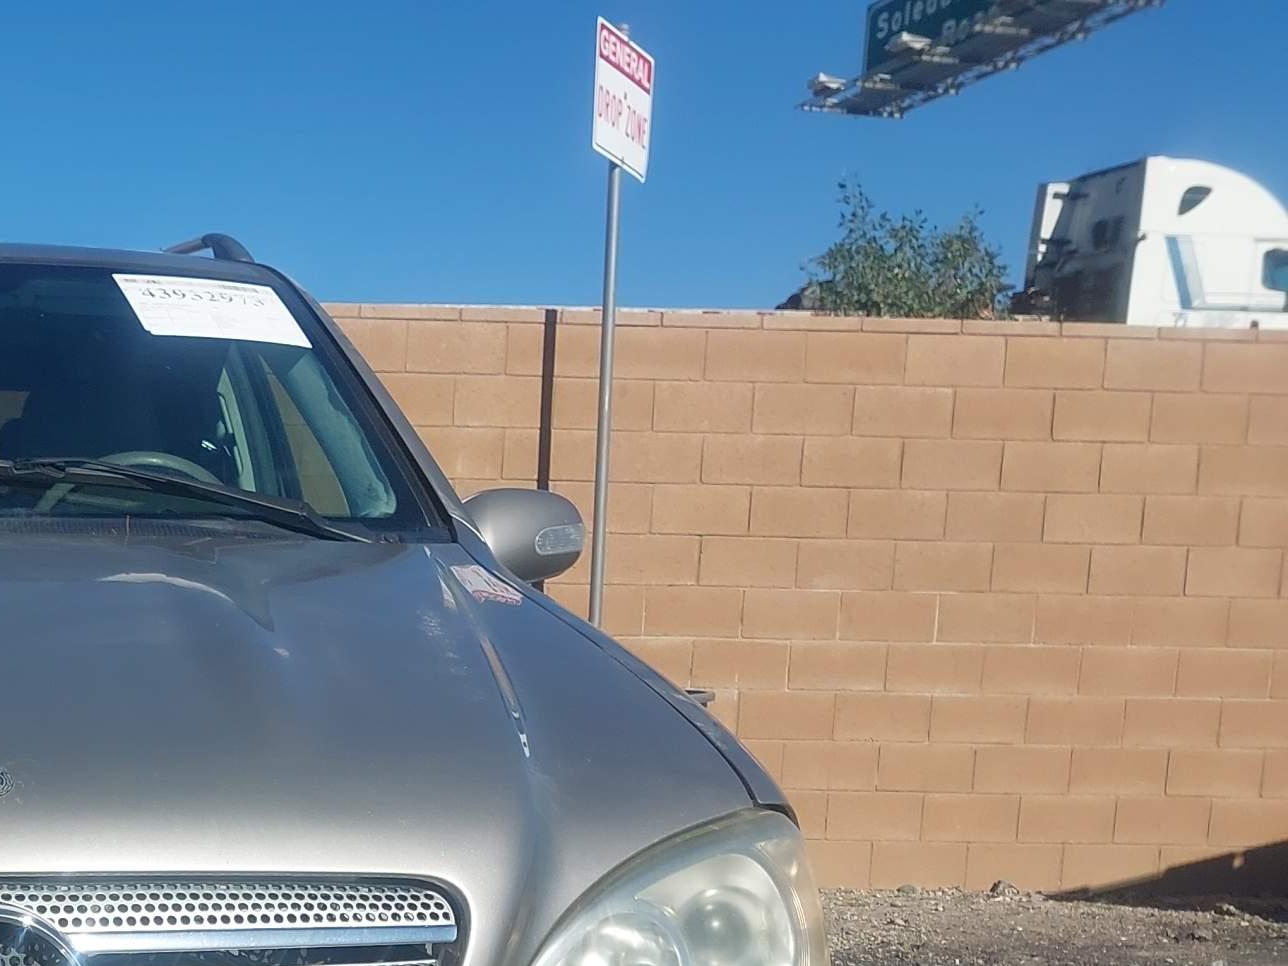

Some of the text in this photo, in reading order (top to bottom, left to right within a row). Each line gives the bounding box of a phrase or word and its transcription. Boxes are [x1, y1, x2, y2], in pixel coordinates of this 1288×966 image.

[600, 29, 650, 89] GENERAL
[597, 86, 648, 150] DROP ZONE
